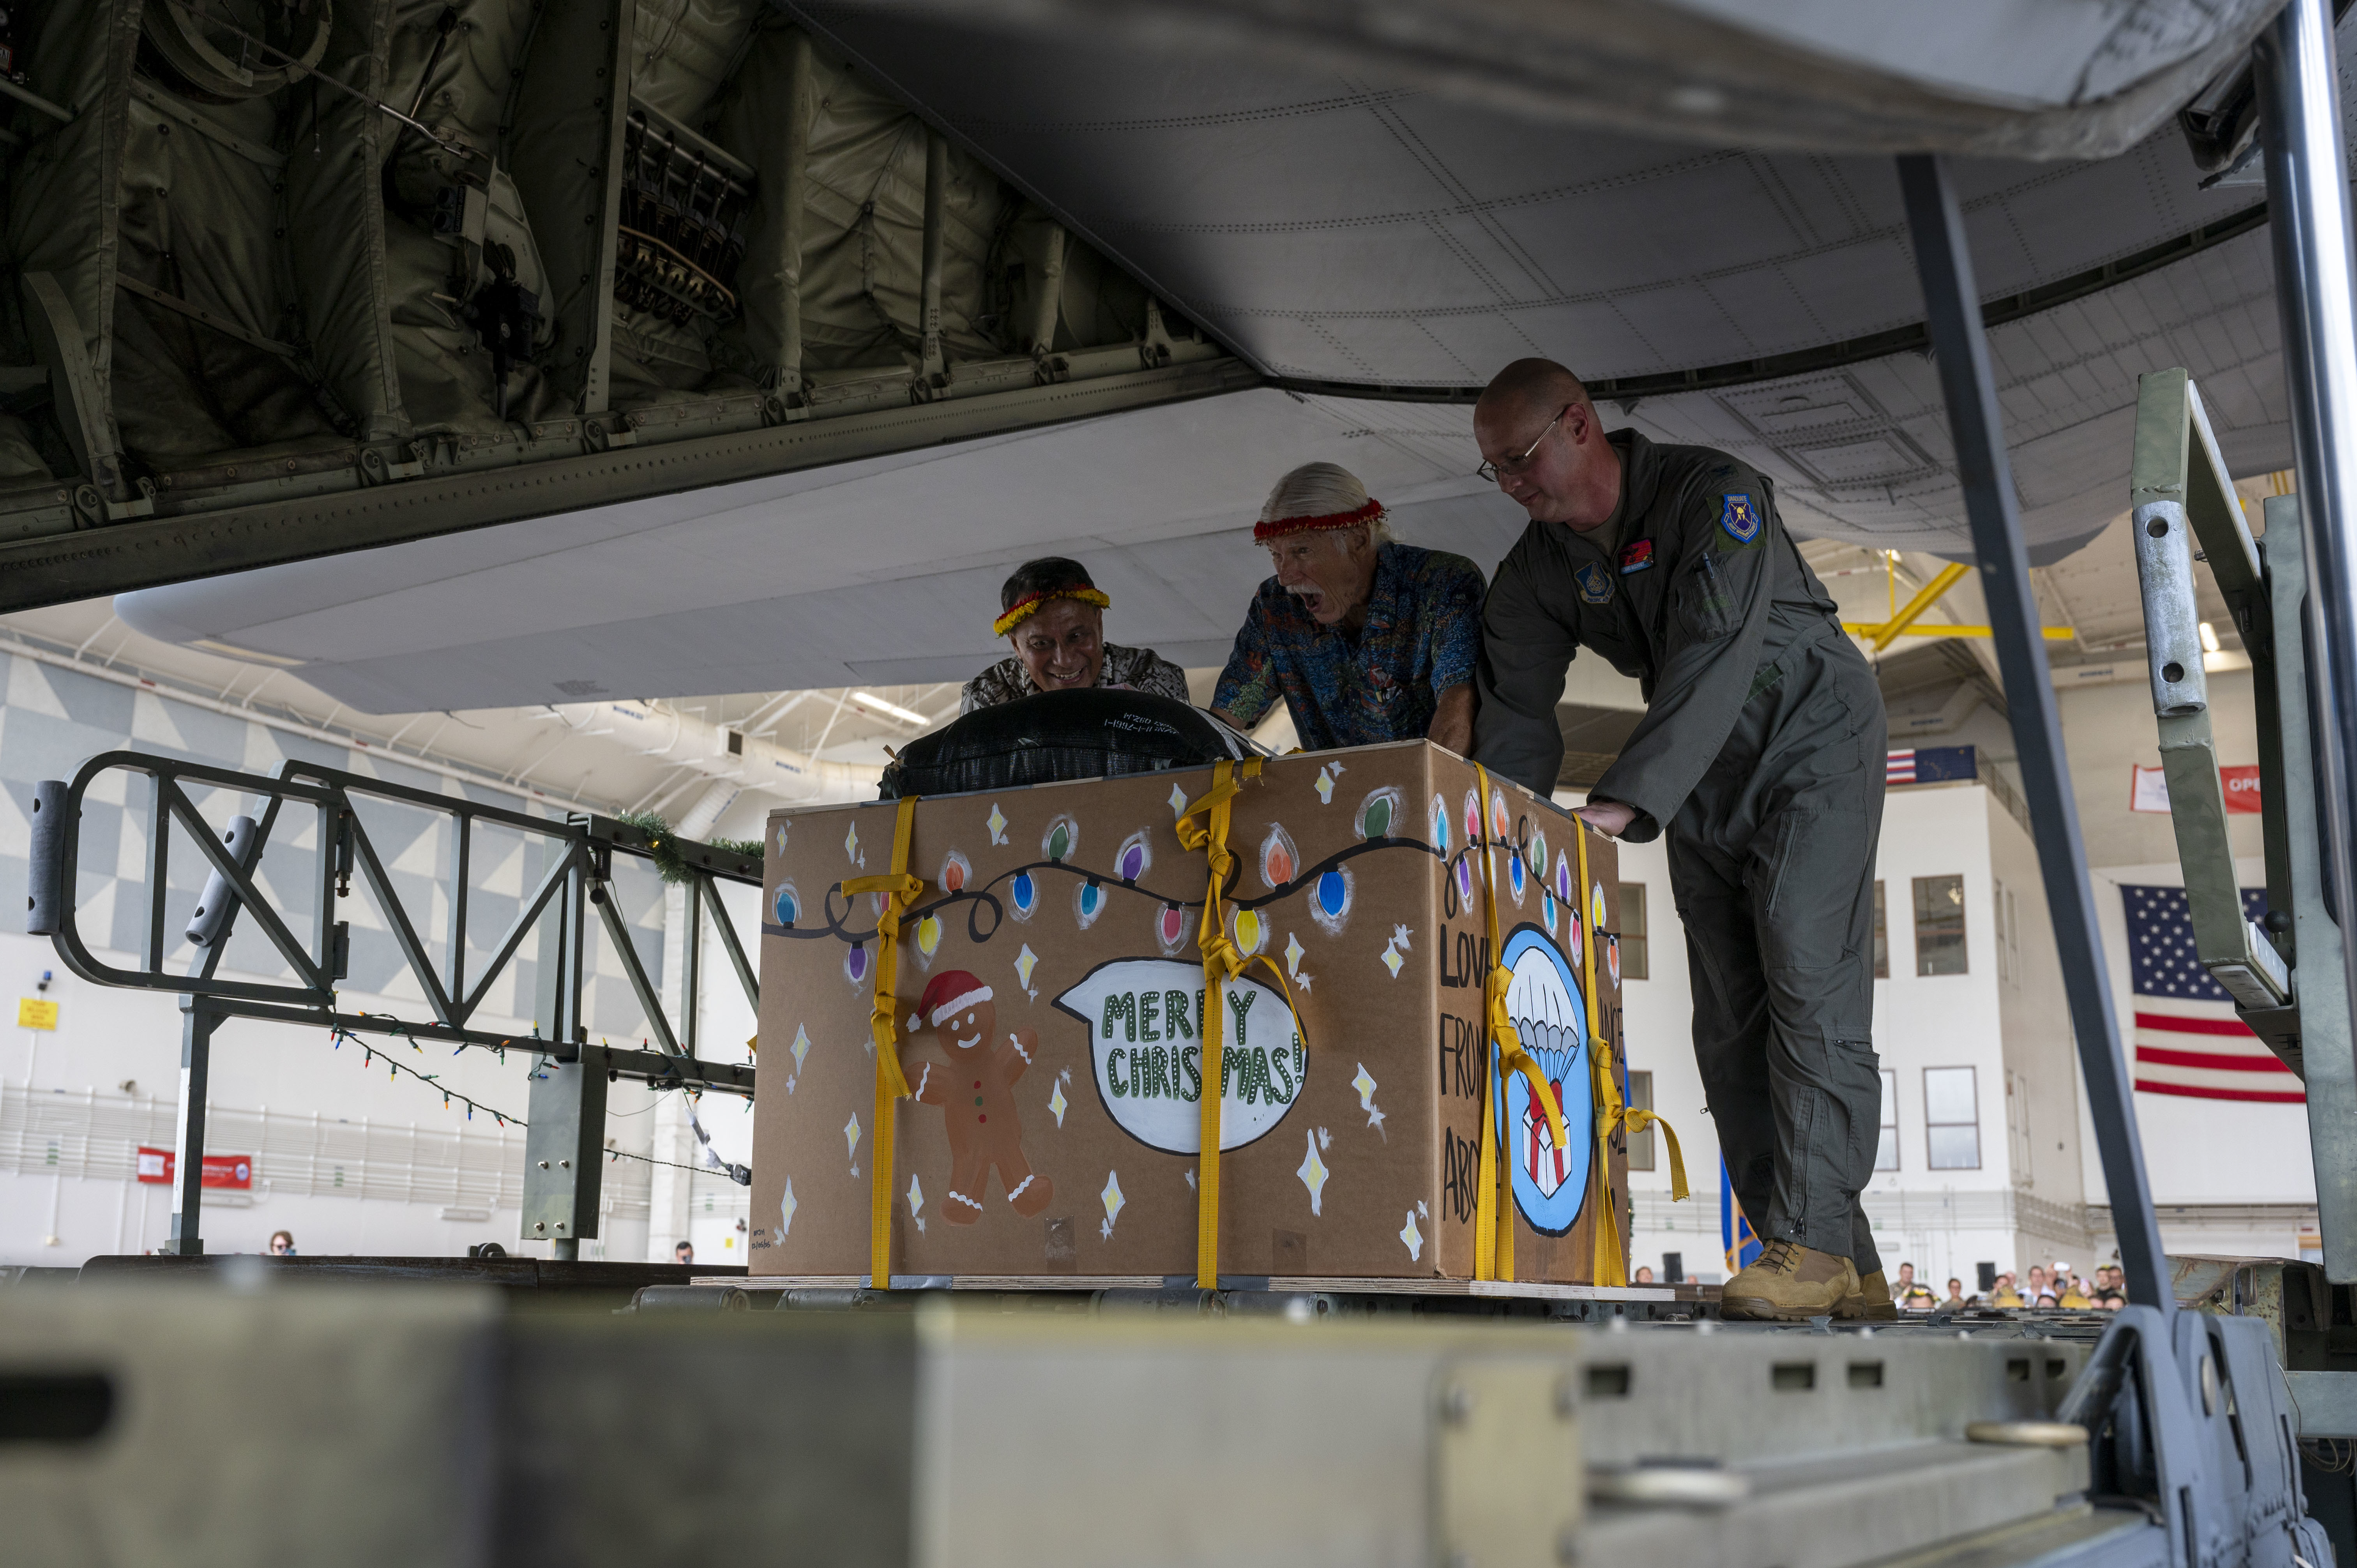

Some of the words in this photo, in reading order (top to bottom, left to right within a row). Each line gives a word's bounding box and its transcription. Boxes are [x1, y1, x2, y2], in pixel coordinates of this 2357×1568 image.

[1101, 990, 1257, 1045] MERY
[1601, 999, 1624, 1065] INCE
[1107, 1031, 1304, 1106] CHRISMAS!
